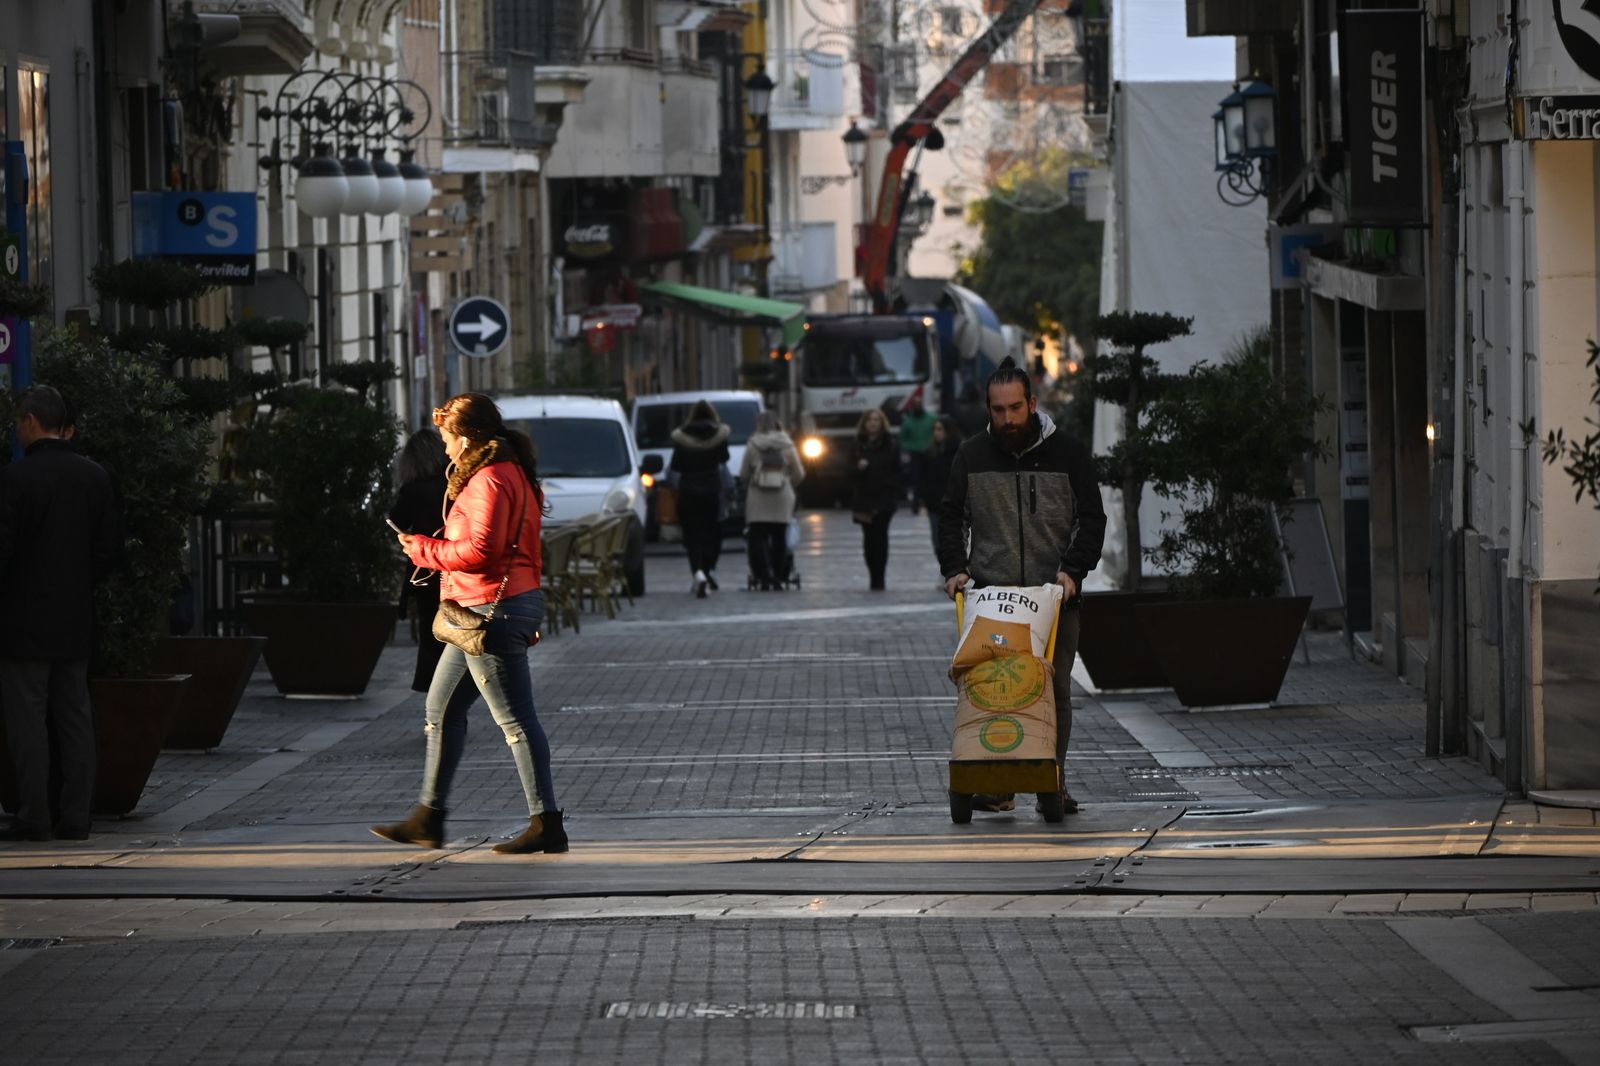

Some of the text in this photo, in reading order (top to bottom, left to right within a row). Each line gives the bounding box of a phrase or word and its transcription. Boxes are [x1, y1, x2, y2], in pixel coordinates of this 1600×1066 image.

[1371, 50, 1399, 183] TIGER
[184, 205, 238, 248] B S
[976, 592, 1039, 613] ALBERO
[998, 603, 1015, 615] 16
